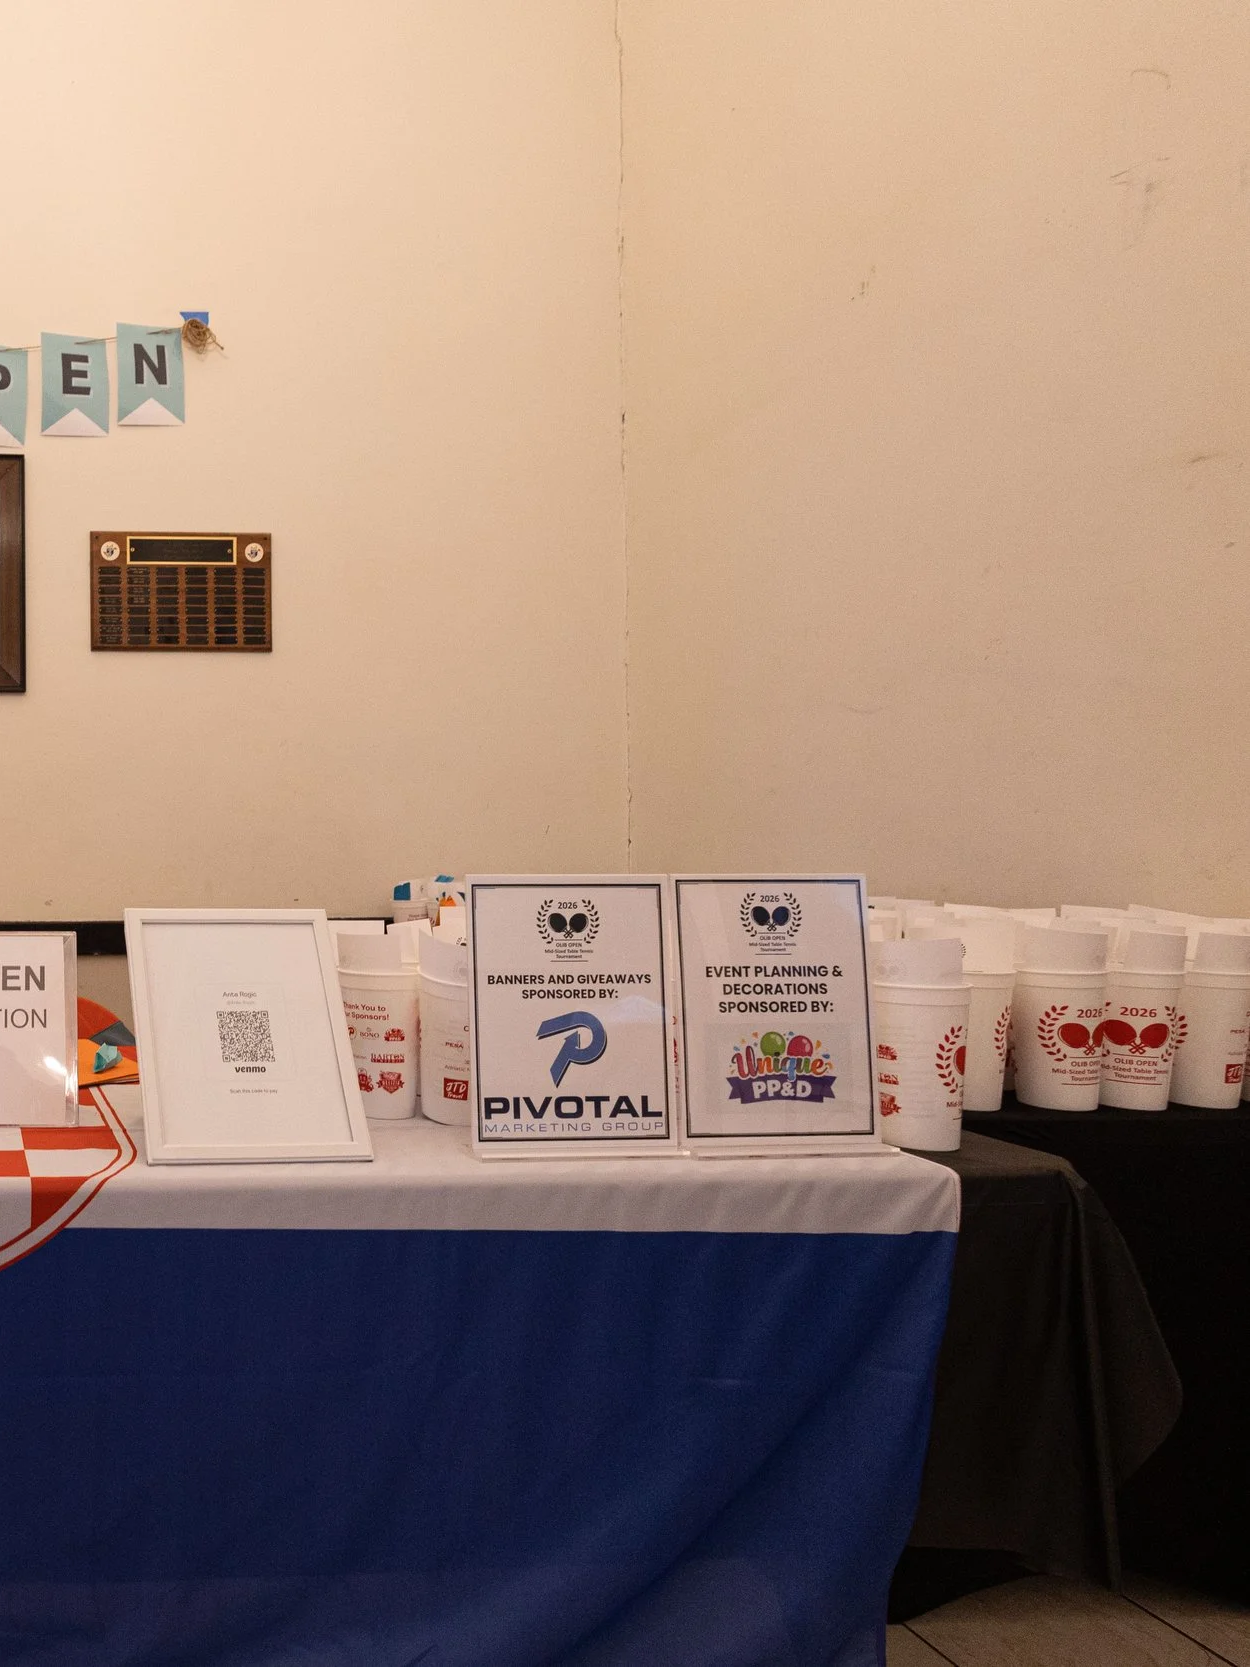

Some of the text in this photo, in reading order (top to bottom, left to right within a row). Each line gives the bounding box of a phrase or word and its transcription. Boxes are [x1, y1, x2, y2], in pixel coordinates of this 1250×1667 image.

[705, 965, 843, 978] EVENT PLANNING &
[487, 974, 651, 985] BANNERS AND GIVEAWAYS
[522, 989, 619, 999] SPONSORED BY:
[722, 983, 828, 995] DECORATIONS
[361, 1004, 375, 1012] You
[719, 1001, 834, 1013] SPONSORED BY:
[1120, 1007, 1157, 1017] 2026
[352, 1012, 389, 1021] Sponsors!
[1077, 1008, 1103, 1018] 2026
[731, 1046, 828, 1081] Unique
[446, 1082, 466, 1094] JTD
[752, 1080, 812, 1099] PP&D
[484, 1095, 662, 1120] PIVOTAL
[485, 1122, 663, 1132] MARKETING GROUP
